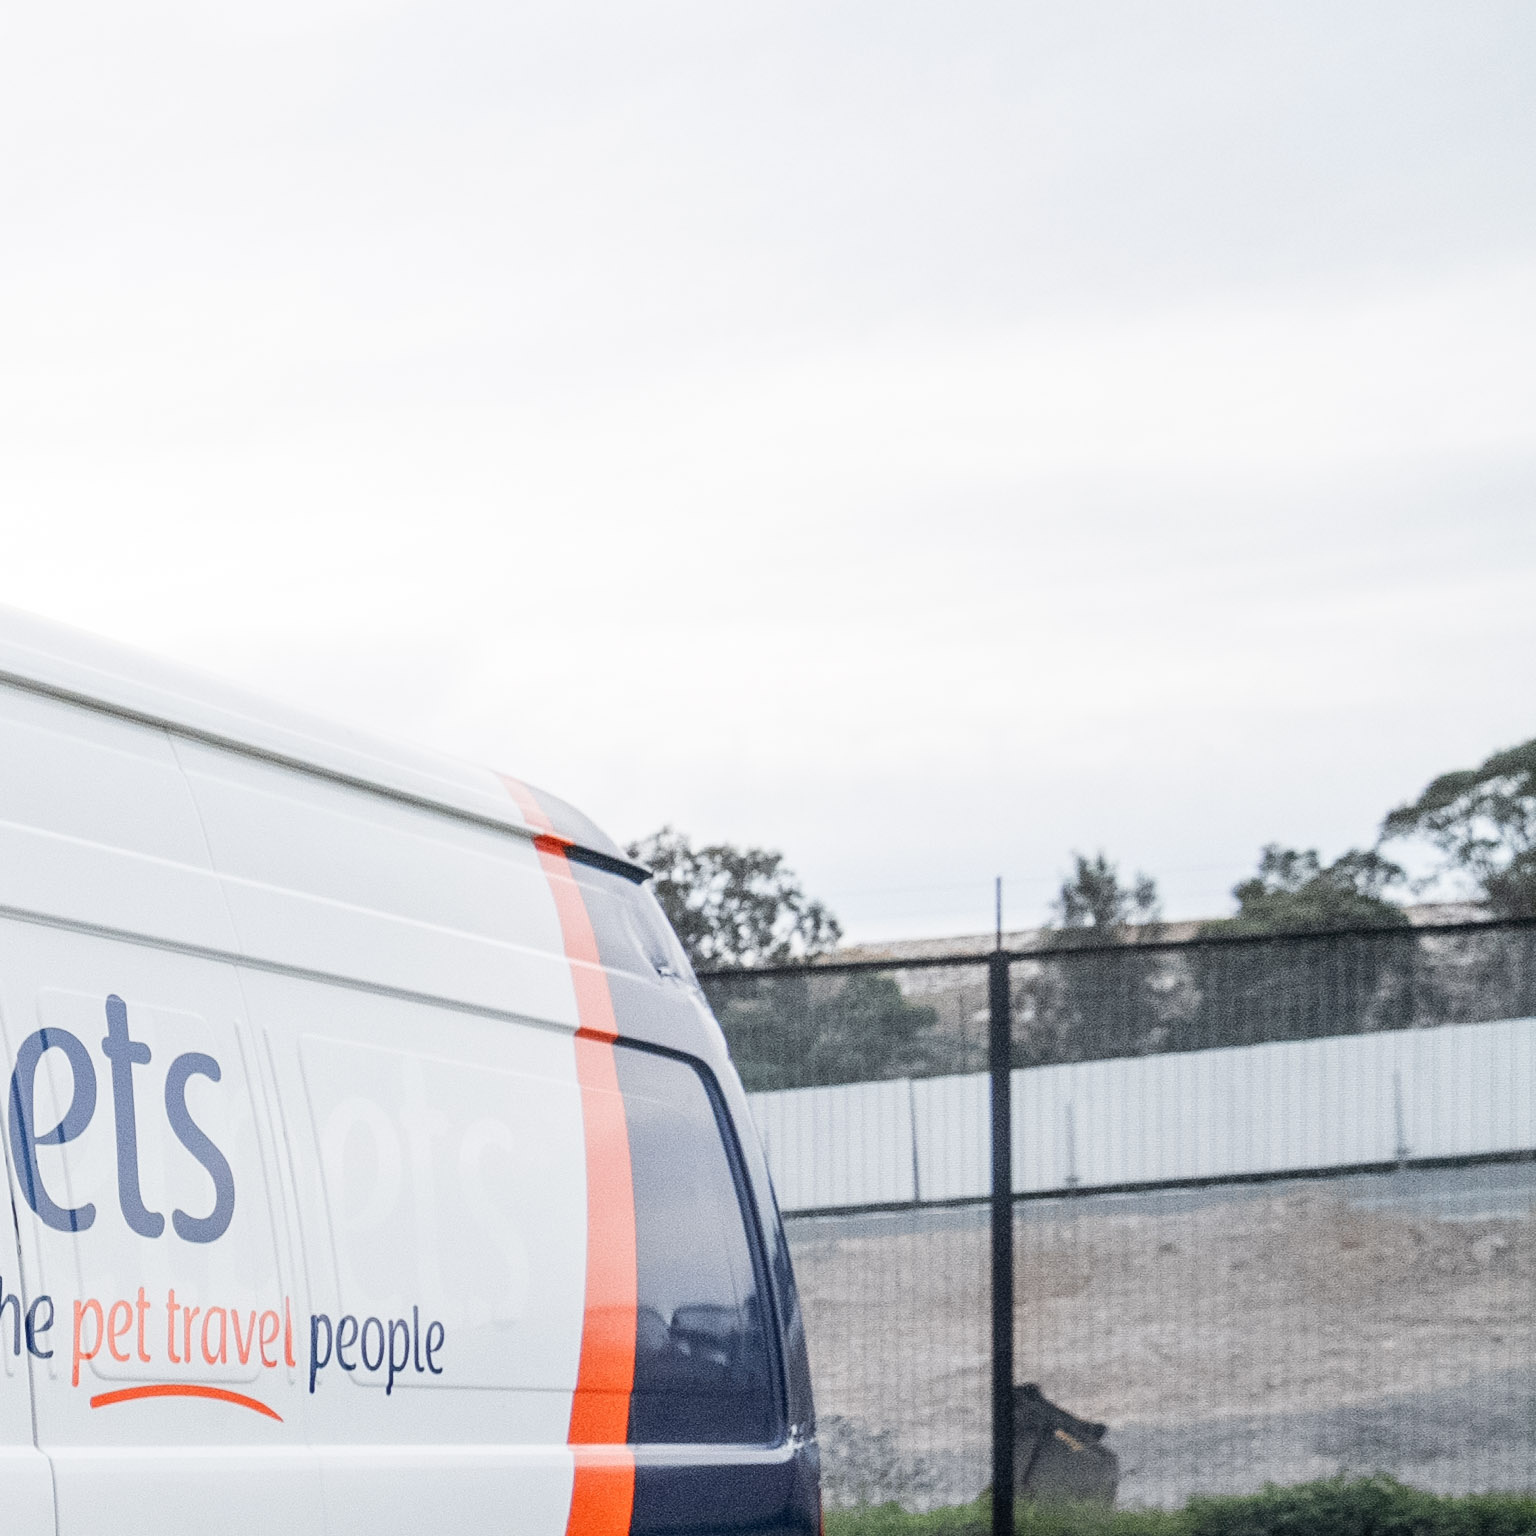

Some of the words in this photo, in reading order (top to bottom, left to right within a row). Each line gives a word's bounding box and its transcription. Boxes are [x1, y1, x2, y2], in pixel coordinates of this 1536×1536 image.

[71, 1286, 151, 1388] pet
[167, 1288, 296, 1368] travel
[309, 1305, 446, 1396] people
